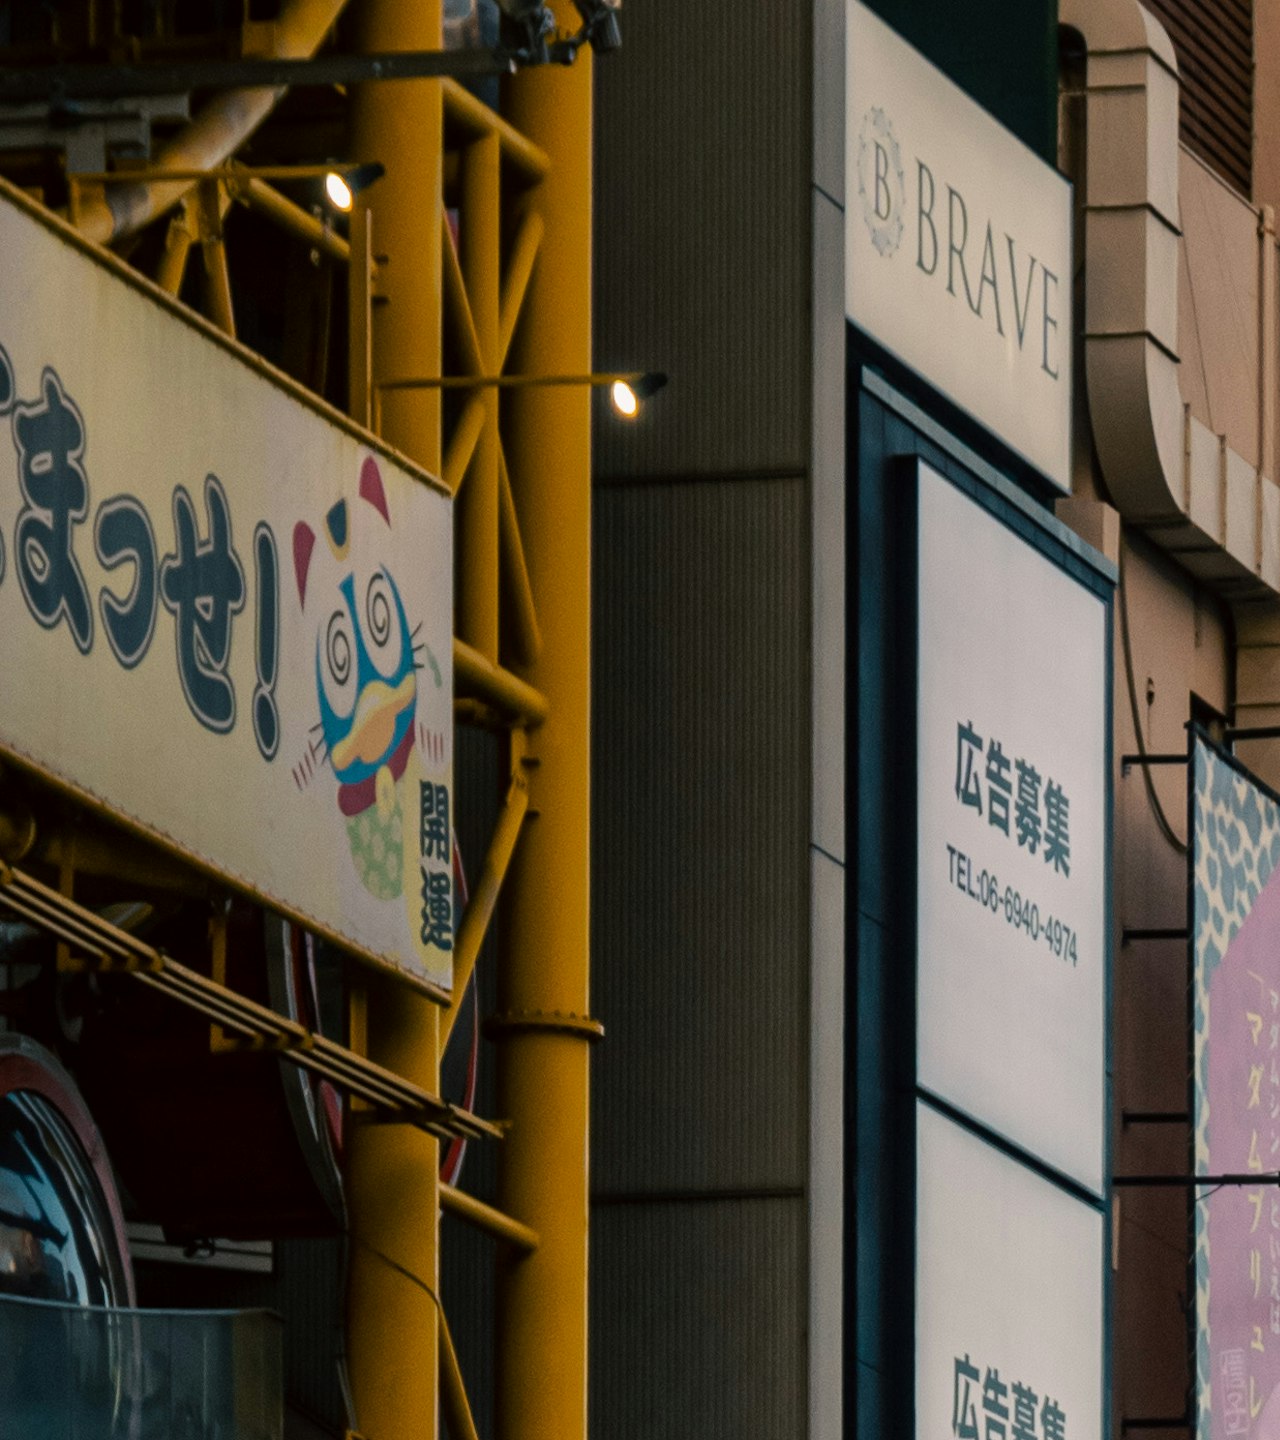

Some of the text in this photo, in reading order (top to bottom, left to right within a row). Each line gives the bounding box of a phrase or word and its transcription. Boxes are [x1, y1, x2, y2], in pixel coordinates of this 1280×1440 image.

[915, 157, 1059, 381] BRAVE
[0, 343, 280, 761] まっせ!
[946, 842, 1078, 968] TEL:06-6940-4974
[955, 719, 1071, 878] 広告募集
[1269, 989, 1280, 1336] マダムシンといえば
